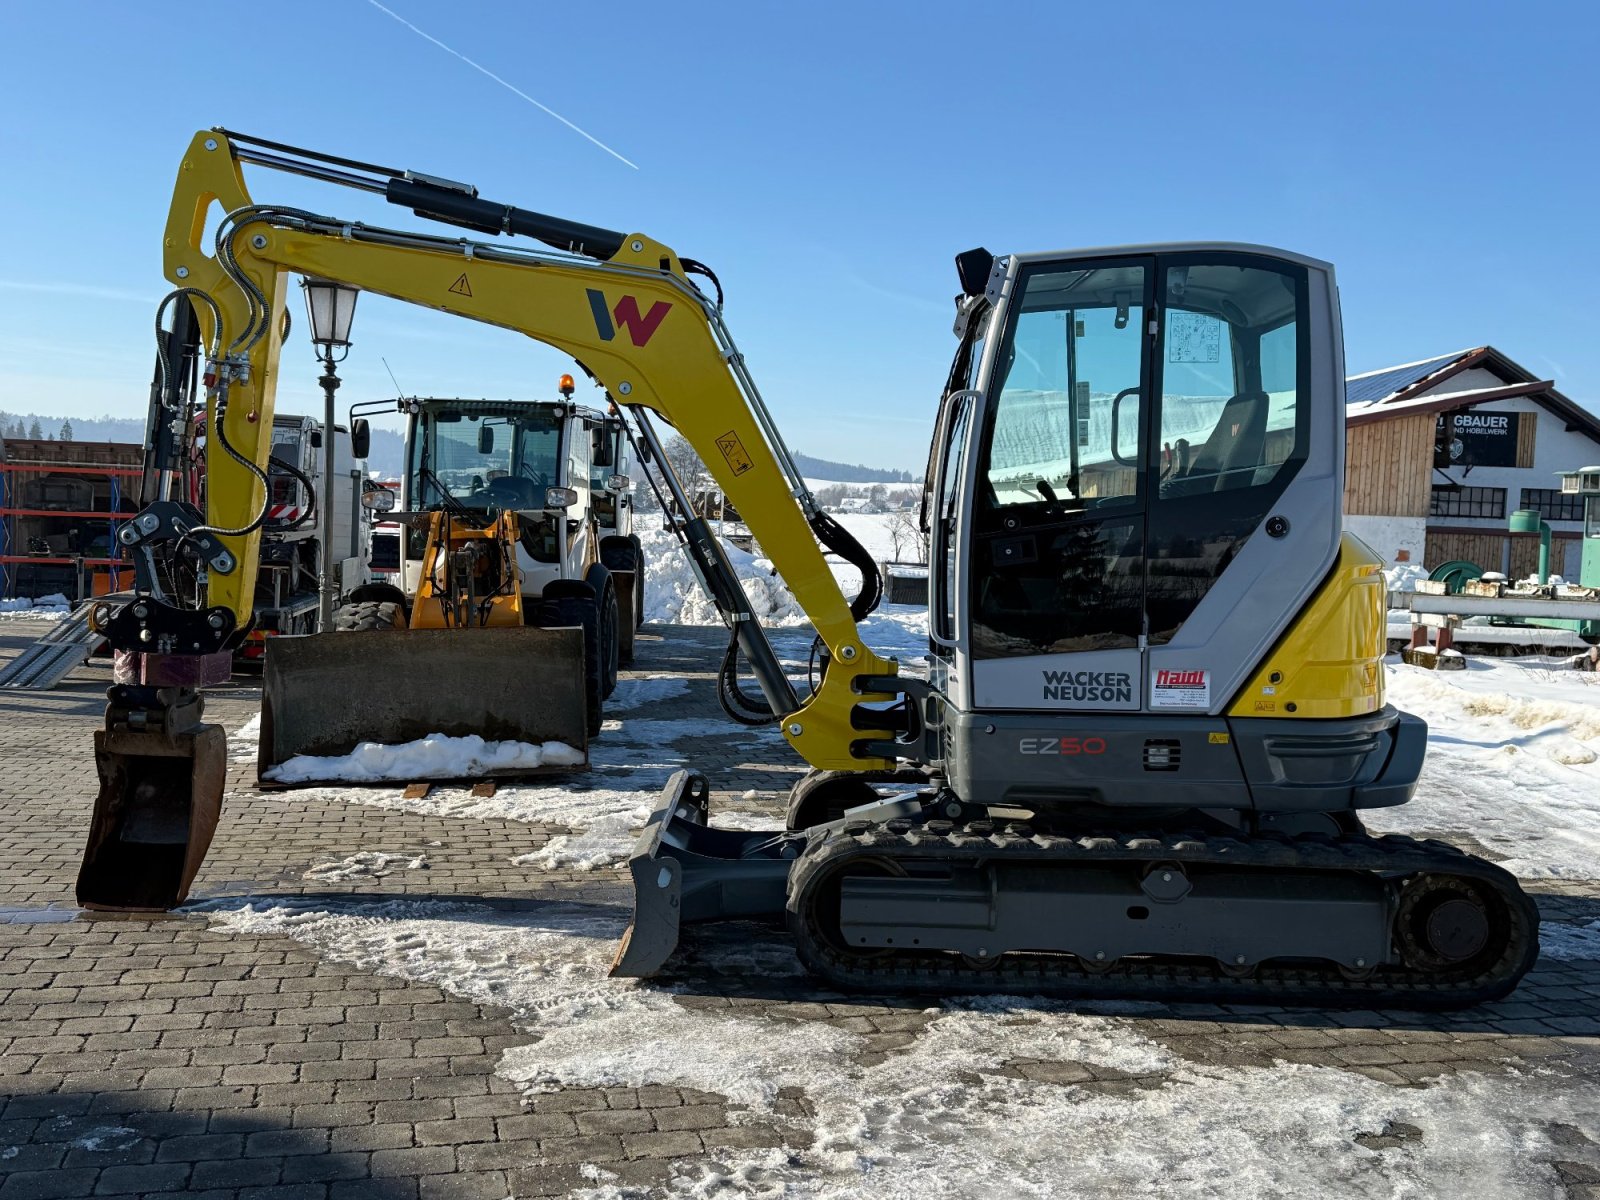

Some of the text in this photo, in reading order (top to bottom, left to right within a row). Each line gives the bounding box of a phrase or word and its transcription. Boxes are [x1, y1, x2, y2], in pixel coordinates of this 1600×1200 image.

[1454, 415, 1508, 428] GBAUER
[1042, 671, 1131, 687] WACKER
[1044, 686, 1131, 702] NEUSON
[1020, 738, 1106, 754] EZ50
